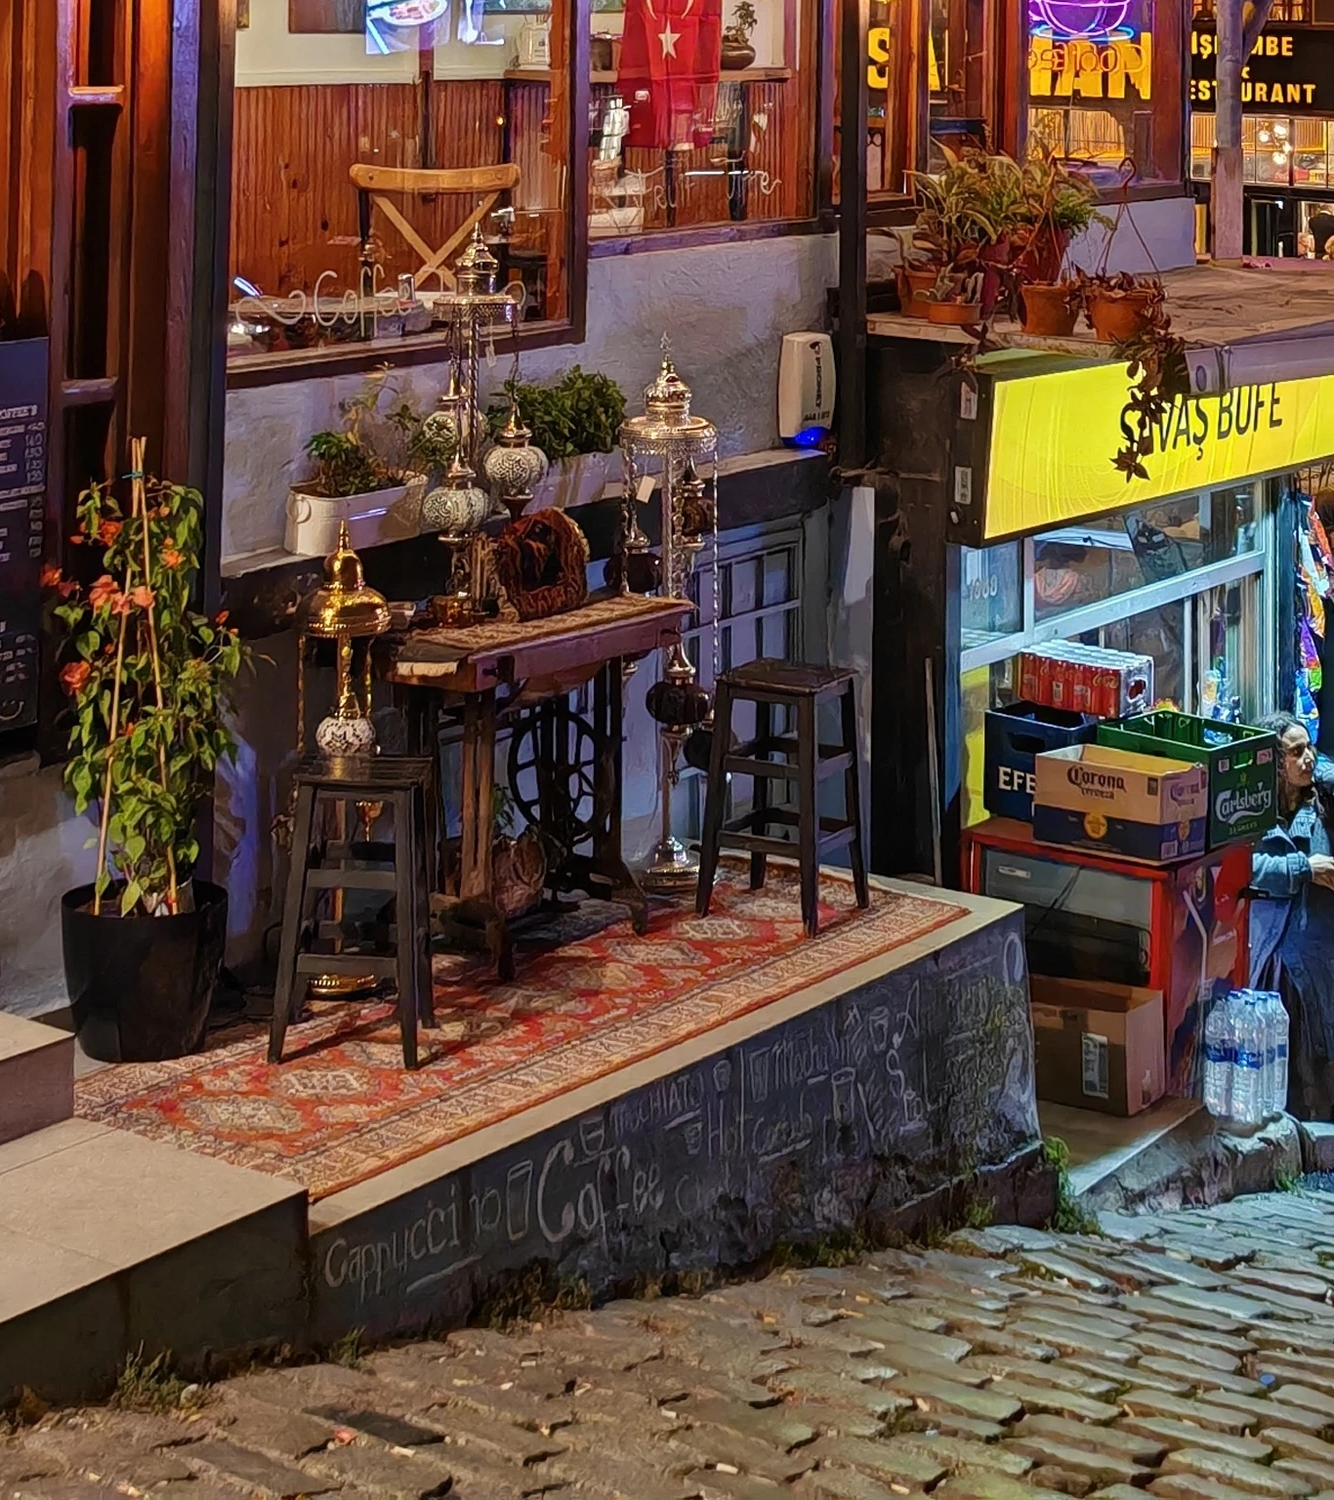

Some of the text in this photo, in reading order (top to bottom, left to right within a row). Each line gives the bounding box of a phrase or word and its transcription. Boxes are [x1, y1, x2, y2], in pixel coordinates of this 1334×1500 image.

[1066, 764, 1127, 793] Corona
[1215, 781, 1273, 823] Carlsberg
[536, 1138, 665, 1258] Coffee
